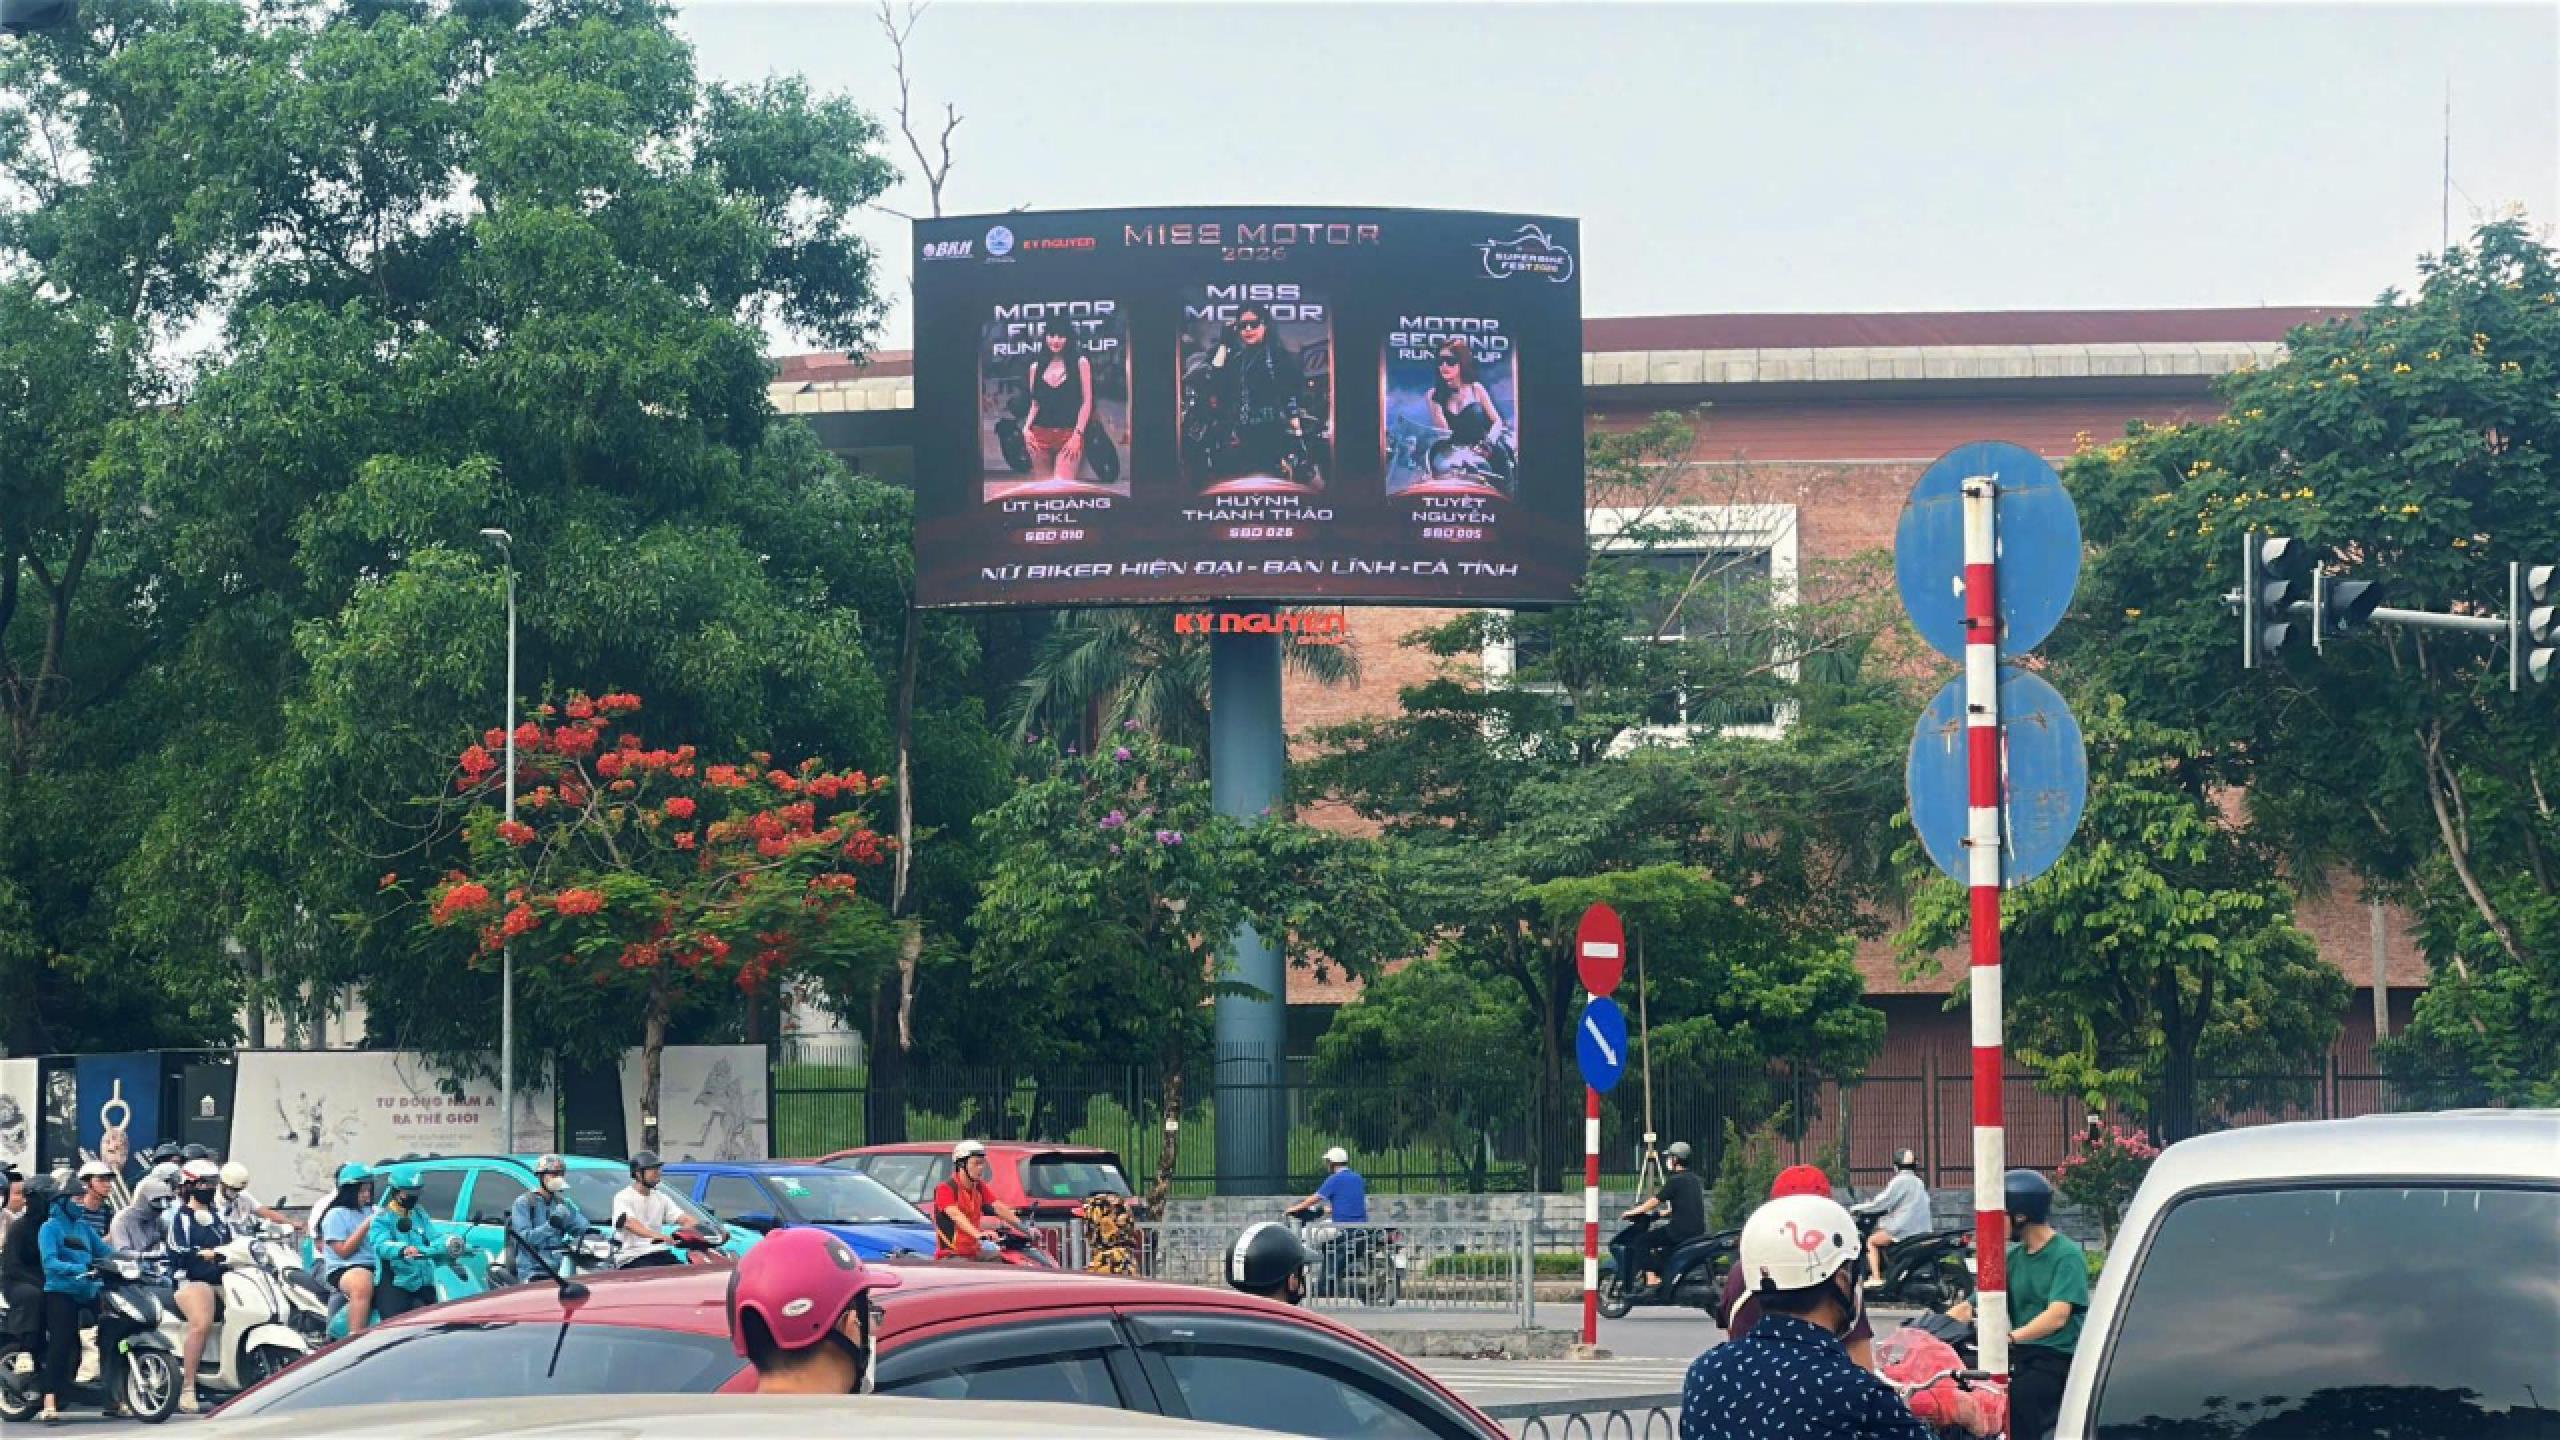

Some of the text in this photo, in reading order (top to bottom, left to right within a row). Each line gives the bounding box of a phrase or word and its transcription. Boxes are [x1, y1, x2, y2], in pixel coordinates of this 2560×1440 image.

[1124, 223, 1380, 246] MISS MOTOR
[1221, 247, 1287, 261] 2026
[1206, 283, 1301, 301] MISS
[993, 300, 1115, 321] MOTOR
[1399, 315, 1499, 332] MOTOR
[1035, 513, 1078, 524] PKL
[1181, 509, 1265, 521] THANH
[1027, 563, 1113, 579] BIKER
